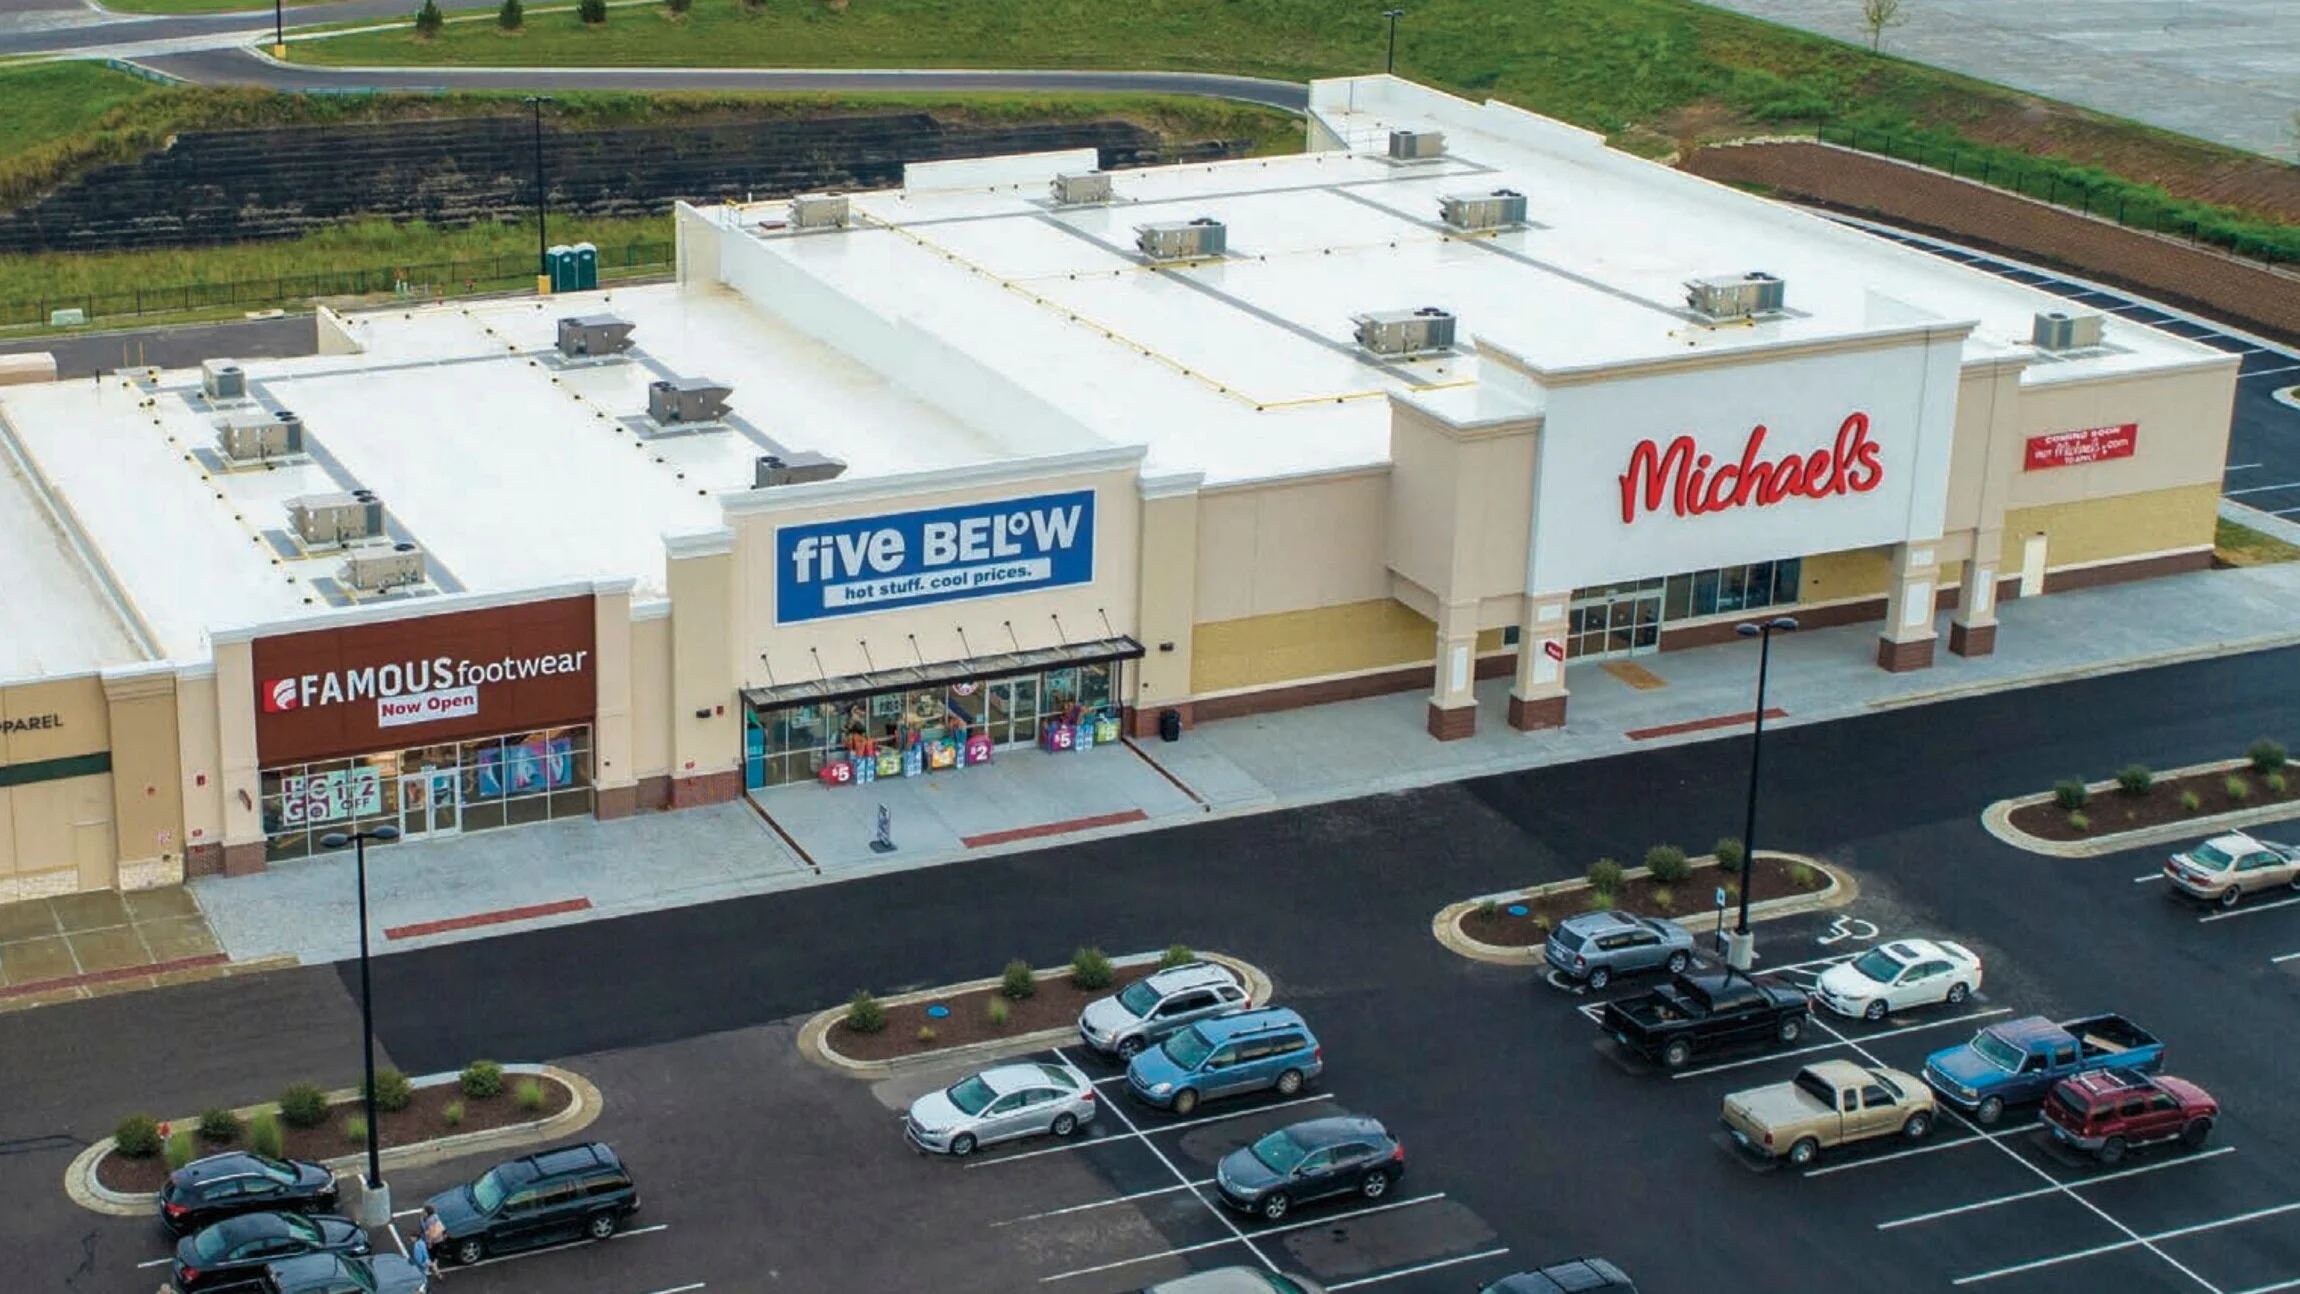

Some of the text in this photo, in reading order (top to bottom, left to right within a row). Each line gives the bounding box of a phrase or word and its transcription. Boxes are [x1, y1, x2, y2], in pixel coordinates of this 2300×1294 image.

[2045, 427, 2121, 444] COMING SOON
[1619, 412, 1883, 524] Michaels
[792, 505, 1082, 583] five BELOW
[845, 566, 1032, 600] hot stuff. cool prices.
[301, 650, 588, 708] FAMOUS footwear
[381, 692, 475, 717] Now Open
[0, 712, 64, 735] PAREL
[970, 744, 988, 761] $2
[831, 763, 850, 781] $5
[341, 798, 370, 810] OFF
